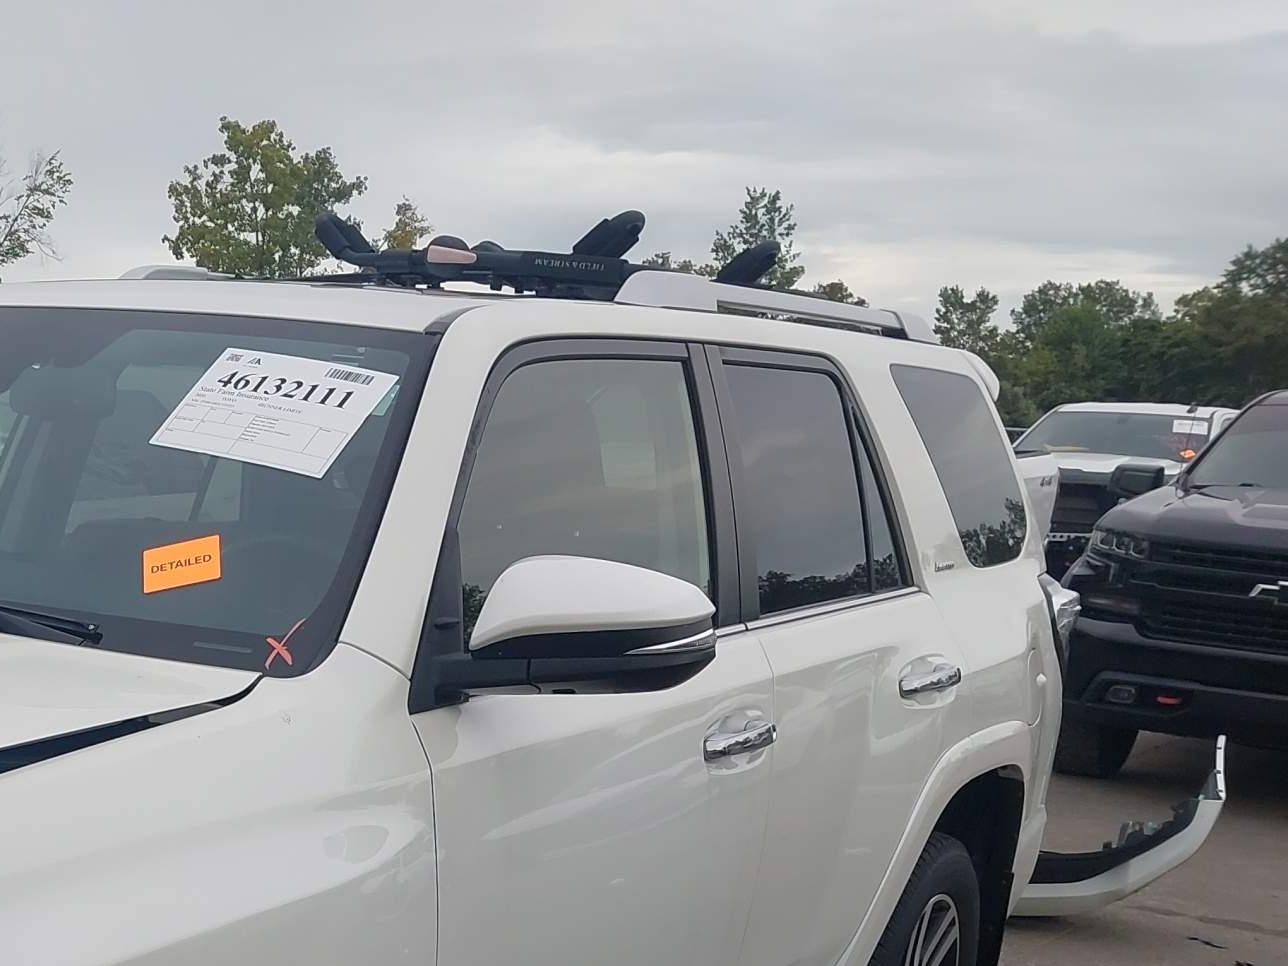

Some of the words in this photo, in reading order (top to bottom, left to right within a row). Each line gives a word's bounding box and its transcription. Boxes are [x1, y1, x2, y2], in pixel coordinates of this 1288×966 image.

[217, 370, 355, 410] 46132111
[236, 391, 270, 402] Insurance
[150, 554, 212, 574] DETAILED
